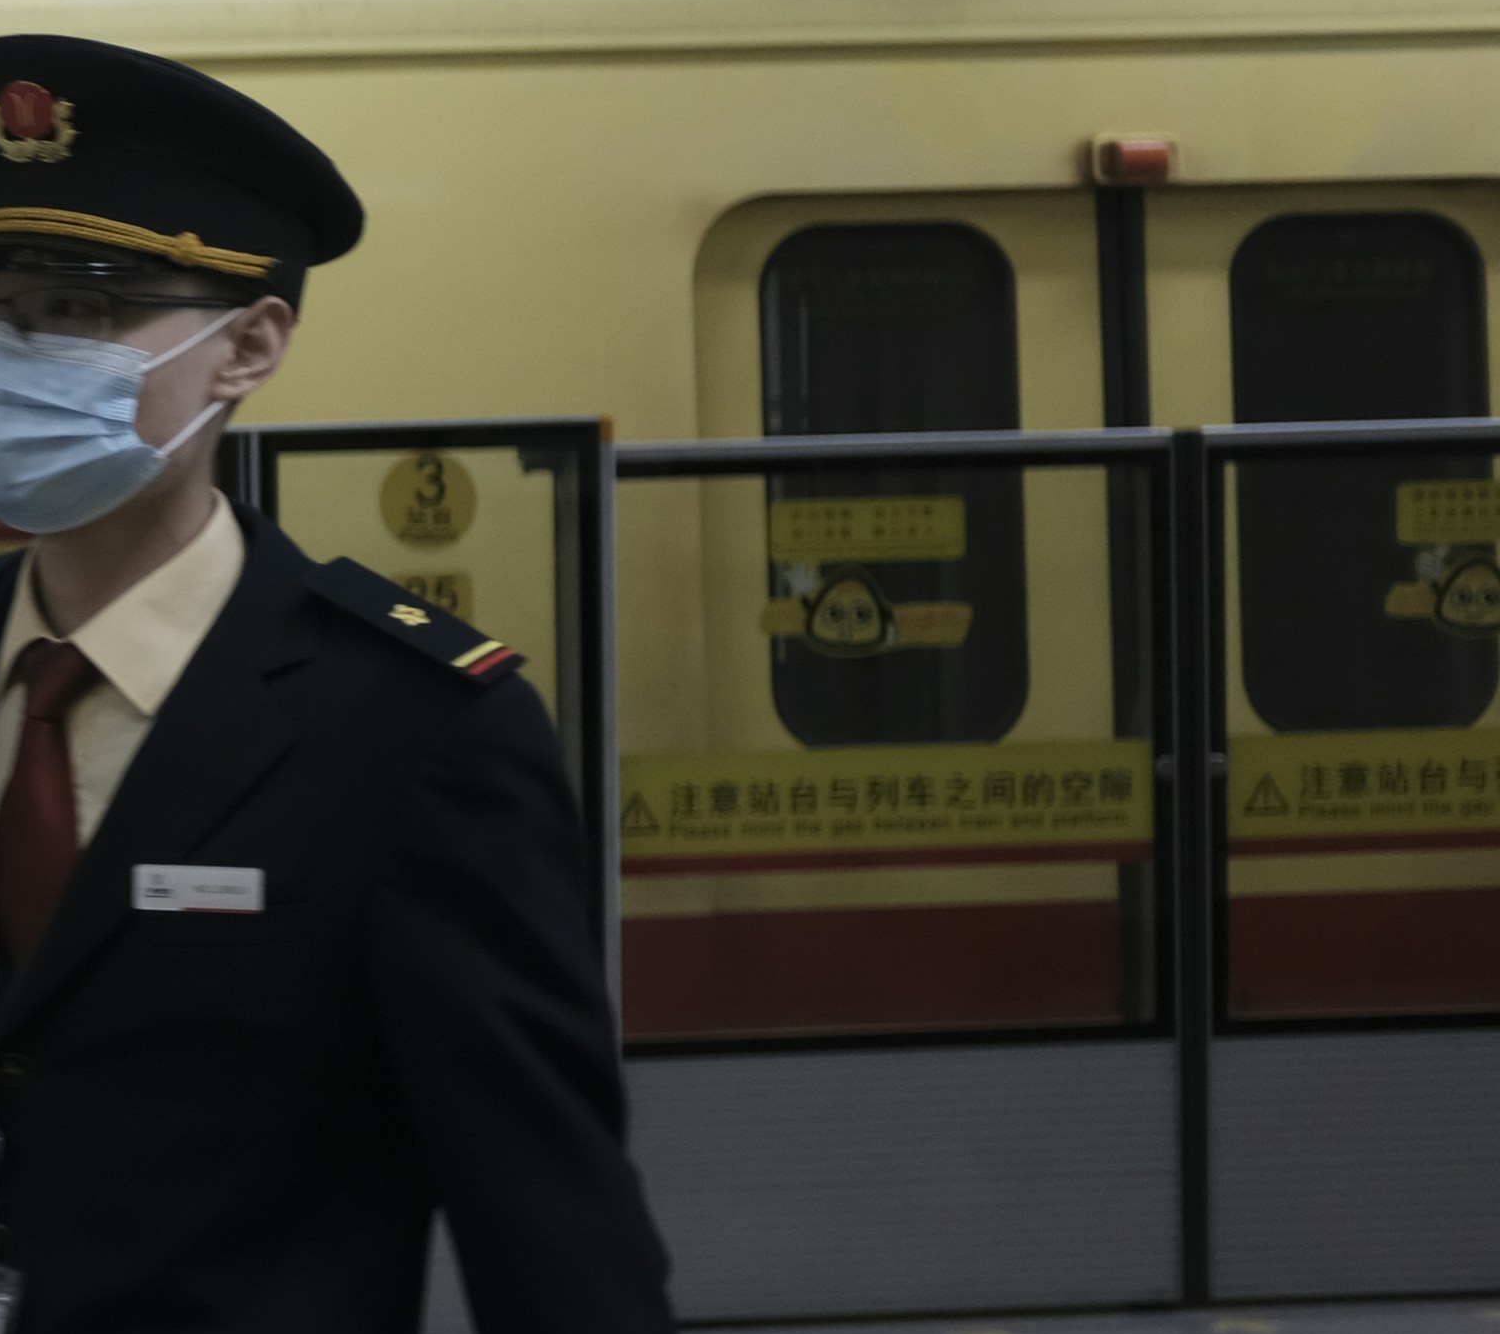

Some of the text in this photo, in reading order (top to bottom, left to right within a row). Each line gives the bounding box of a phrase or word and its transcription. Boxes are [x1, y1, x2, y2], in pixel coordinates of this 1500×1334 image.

[417, 454, 445, 506] 3
[670, 768, 1133, 818] 注意站台与列车之间的空隙
[1299, 756, 1500, 798] 注意站台与
